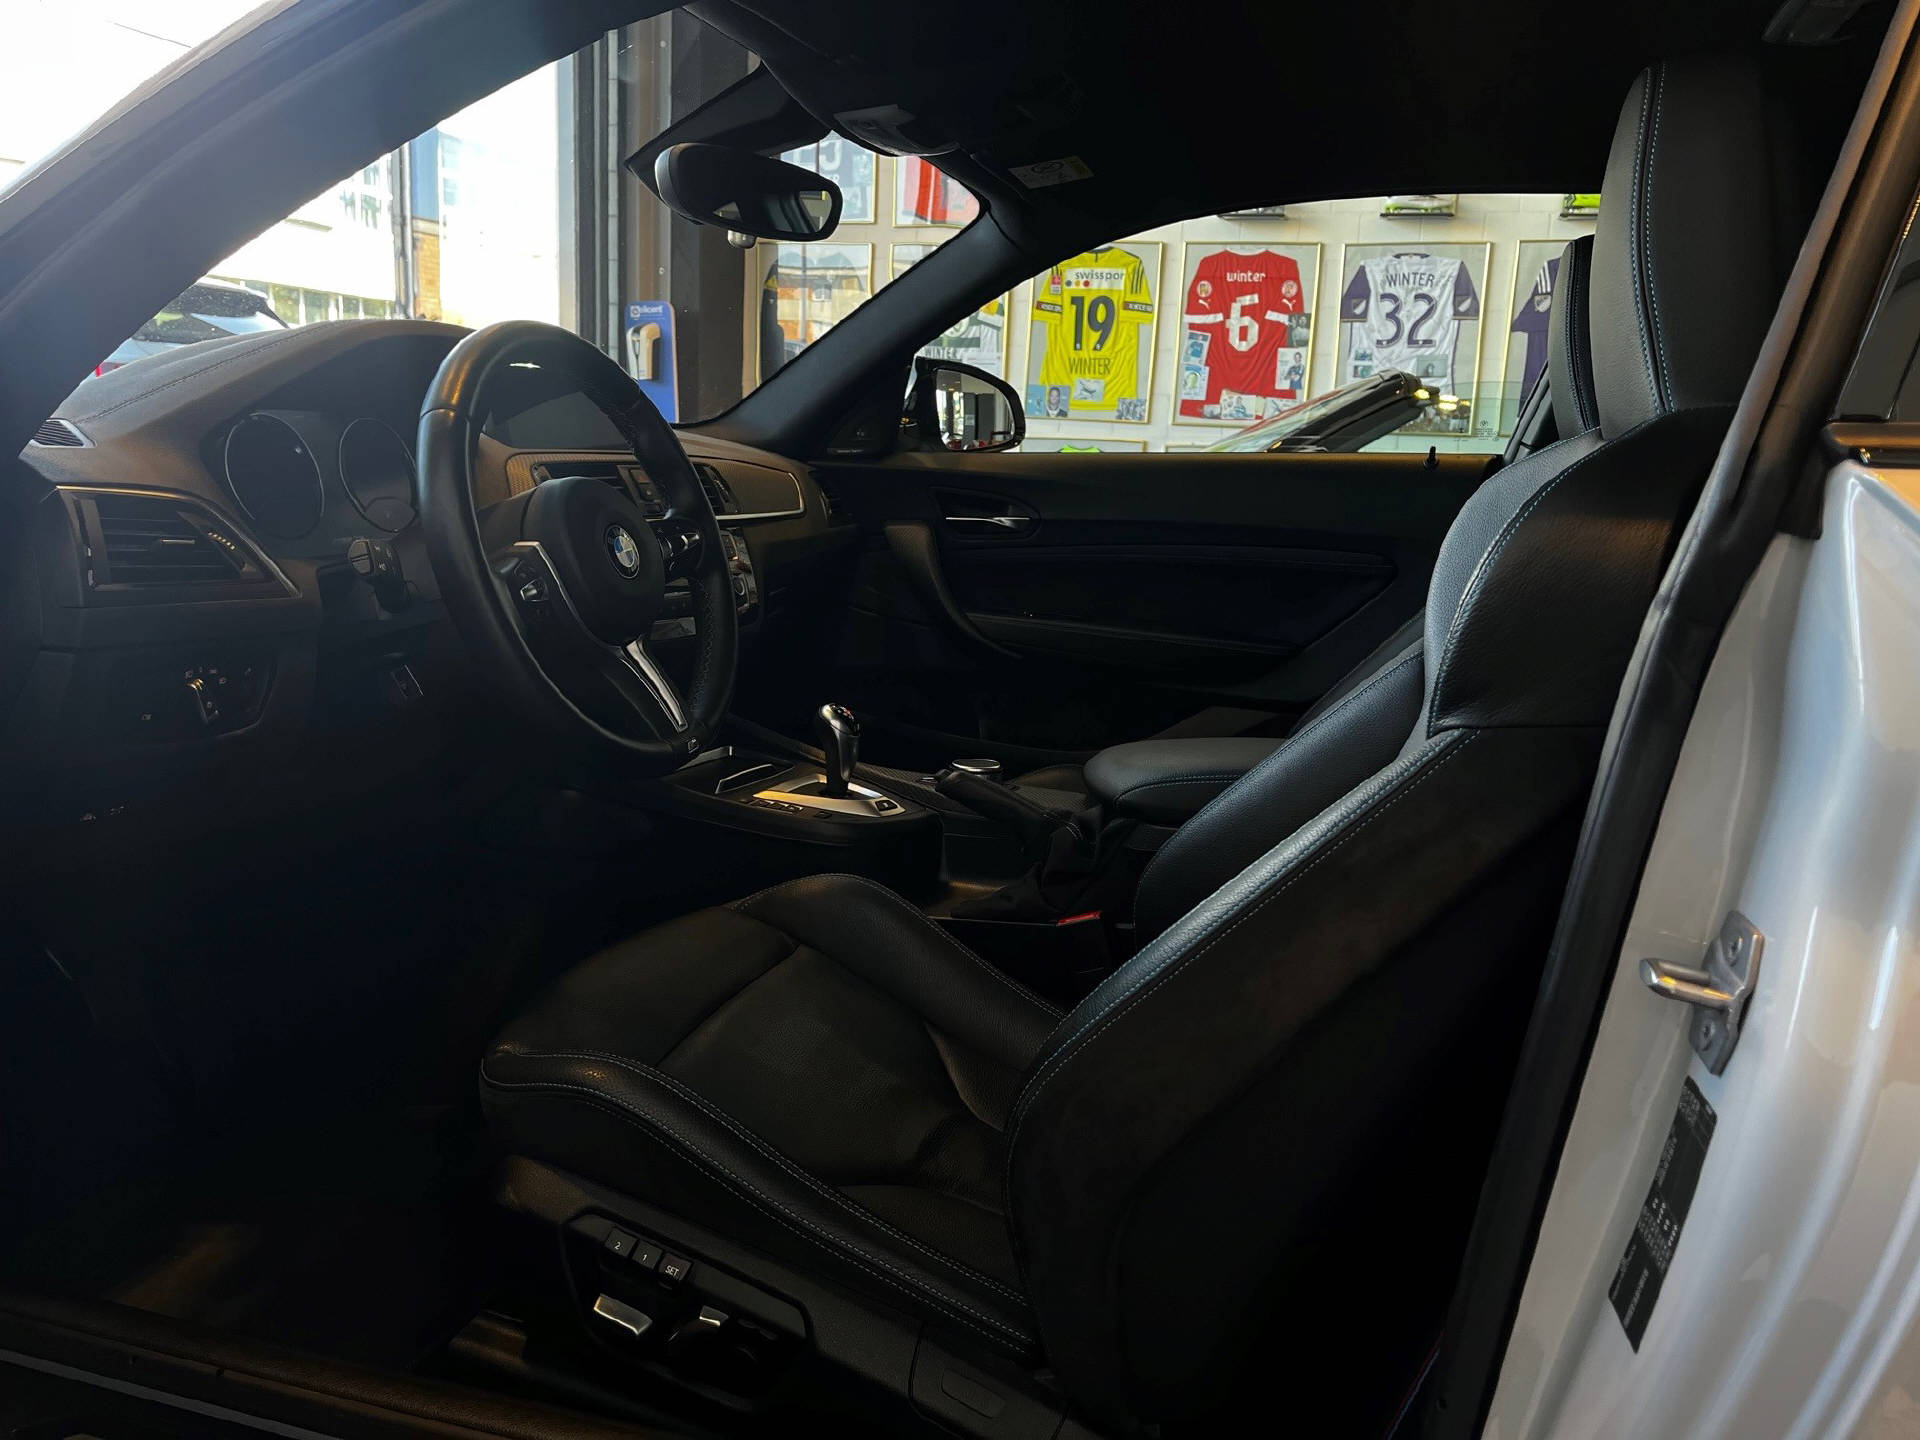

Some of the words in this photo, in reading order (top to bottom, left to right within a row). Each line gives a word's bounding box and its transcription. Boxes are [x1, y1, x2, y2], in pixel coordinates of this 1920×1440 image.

[1074, 269, 1125, 281] swisspor
[1226, 271, 1267, 283] winter
[1385, 270, 1436, 288] WINTER
[1070, 294, 1117, 352] 19
[1225, 293, 1260, 352] 6
[1375, 292, 1436, 348] 32
[1068, 356, 1111, 376] WINTER
[615, 1241, 621, 1250] 2
[642, 1254, 647, 1262] 1
[665, 1265, 679, 1277] SET
